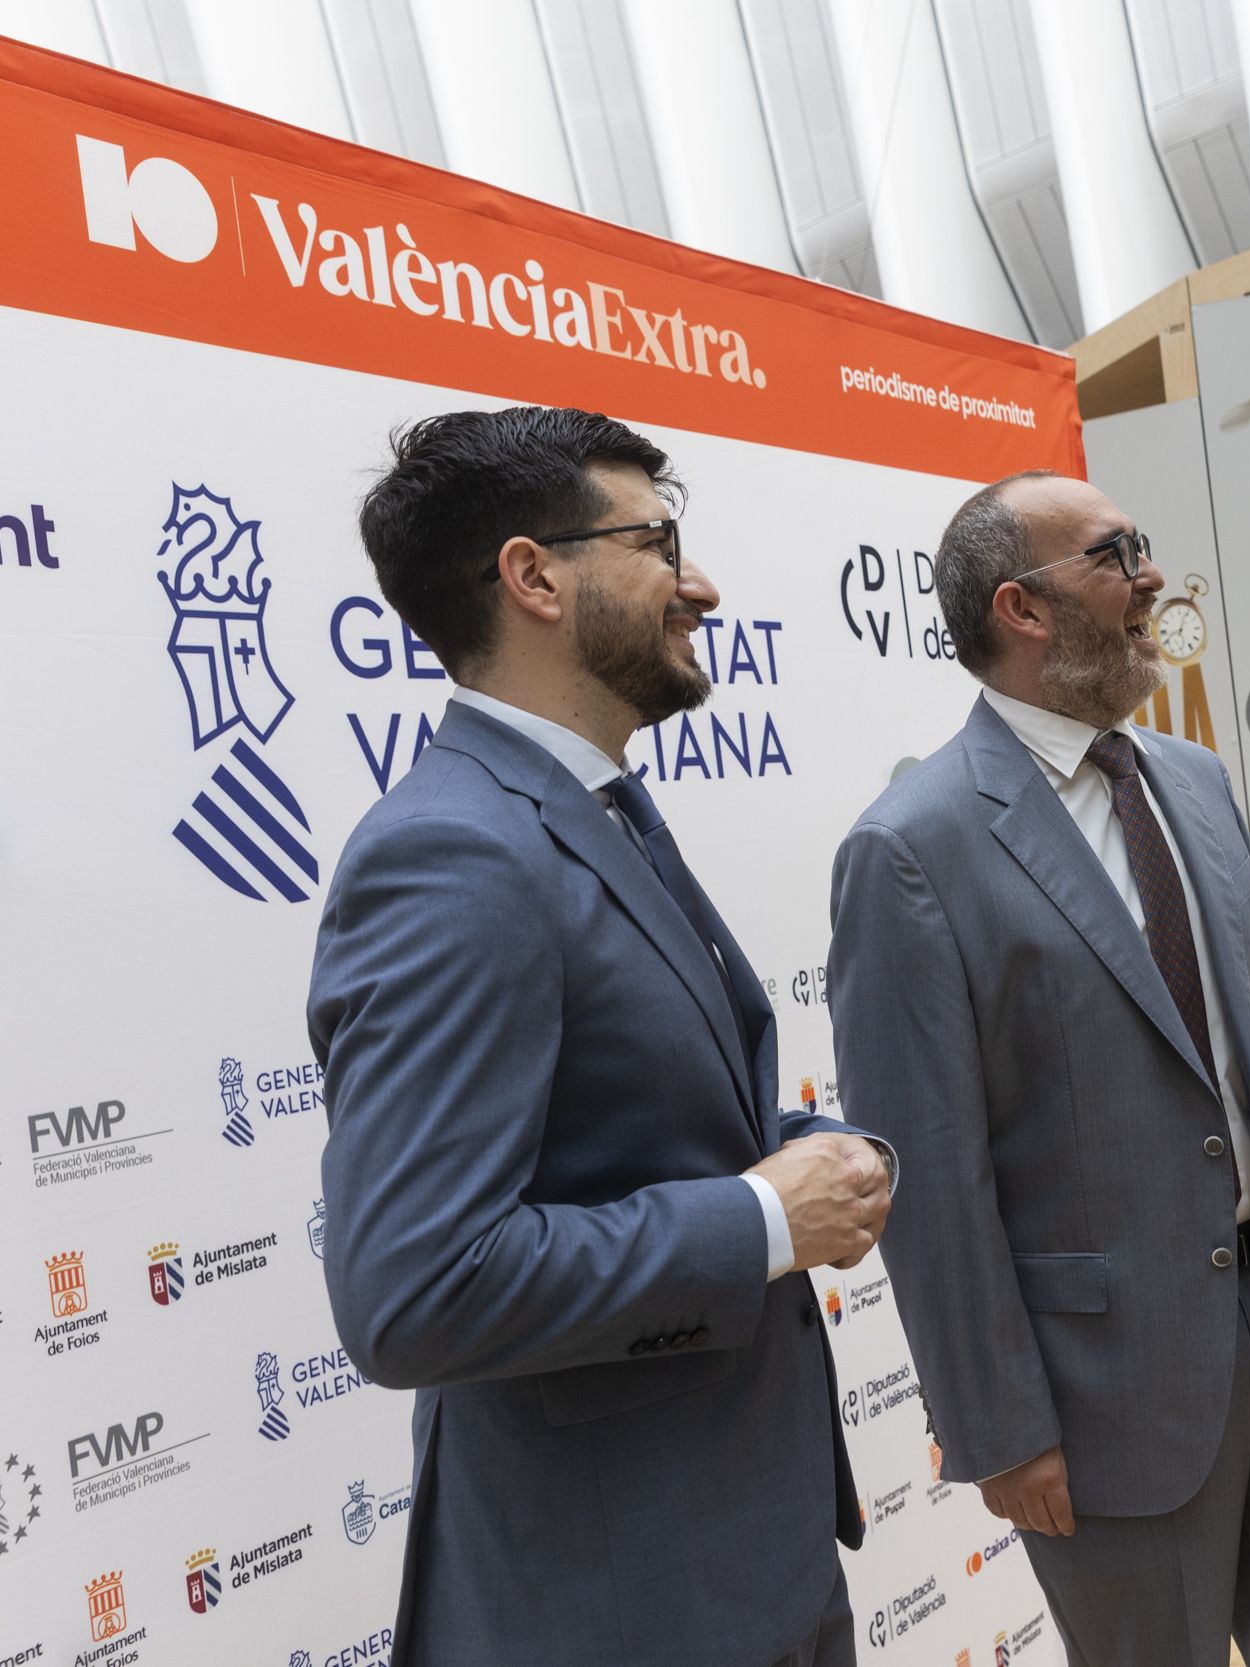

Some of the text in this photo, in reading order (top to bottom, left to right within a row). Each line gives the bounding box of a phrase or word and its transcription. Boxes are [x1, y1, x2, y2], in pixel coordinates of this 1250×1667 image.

[840, 365, 1036, 429] periodisme de proximitat
[924, 616, 957, 660] de
[261, 1088, 326, 1118] VALEN
[33, 1144, 136, 1175] Federació Valenciana
[35, 1172, 48, 1188] de
[50, 1164, 98, 1185] Municipis
[193, 1232, 277, 1268] Ajuntament
[195, 1256, 267, 1286] de Mislata
[850, 1276, 888, 1301] Ajuntament
[851, 1291, 882, 1314] de Puçol
[34, 1310, 108, 1343] Ajuntament
[47, 1332, 100, 1356] de Foios
[296, 1369, 373, 1408] VALEN
[866, 1363, 910, 1397] Diputació
[868, 1382, 920, 1418] de València
[73, 1455, 174, 1500] Federació Valenciana
[75, 1498, 88, 1513] de
[89, 1480, 137, 1507] Municipis
[379, 1497, 410, 1519] Cata
[874, 1481, 912, 1510] Ajuntament
[875, 1512, 884, 1524] de
[230, 1523, 313, 1571] Ajuntament
[984, 1536, 1010, 1561] Caixa
[232, 1548, 303, 1589] de Mislata
[893, 1575, 936, 1617] Diputació
[896, 1592, 946, 1637] de València
[74, 1627, 147, 1667] Ajuntament
